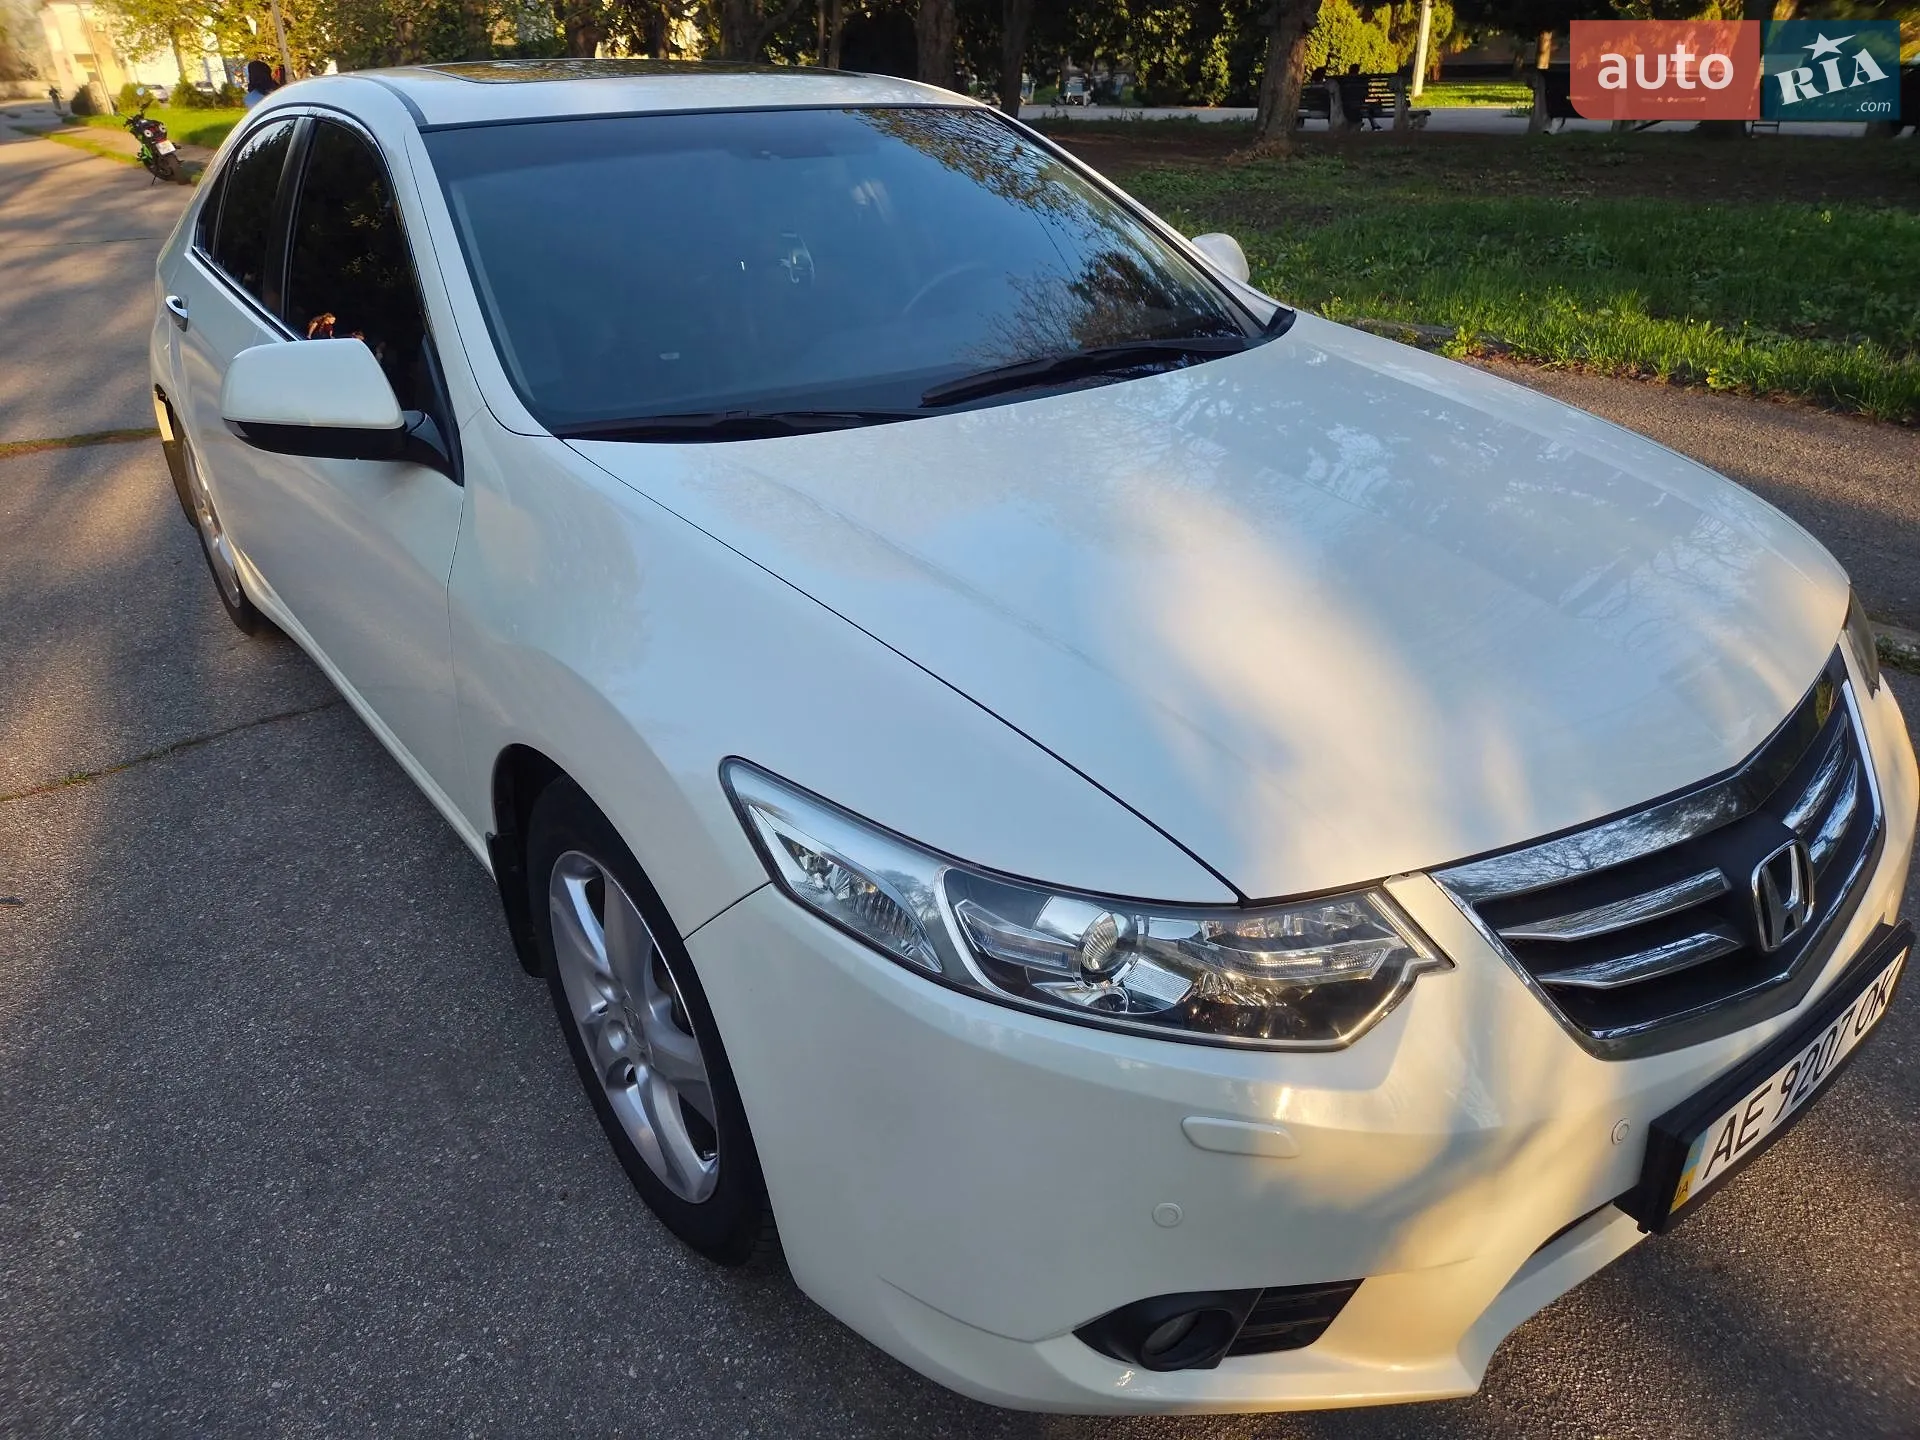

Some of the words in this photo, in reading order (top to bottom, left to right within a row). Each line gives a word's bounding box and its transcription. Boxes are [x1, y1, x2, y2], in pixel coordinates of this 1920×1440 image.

[1702, 1082, 1773, 1180] AE
[1771, 1004, 1857, 1123] 9207
[1855, 955, 1903, 1036] OK
